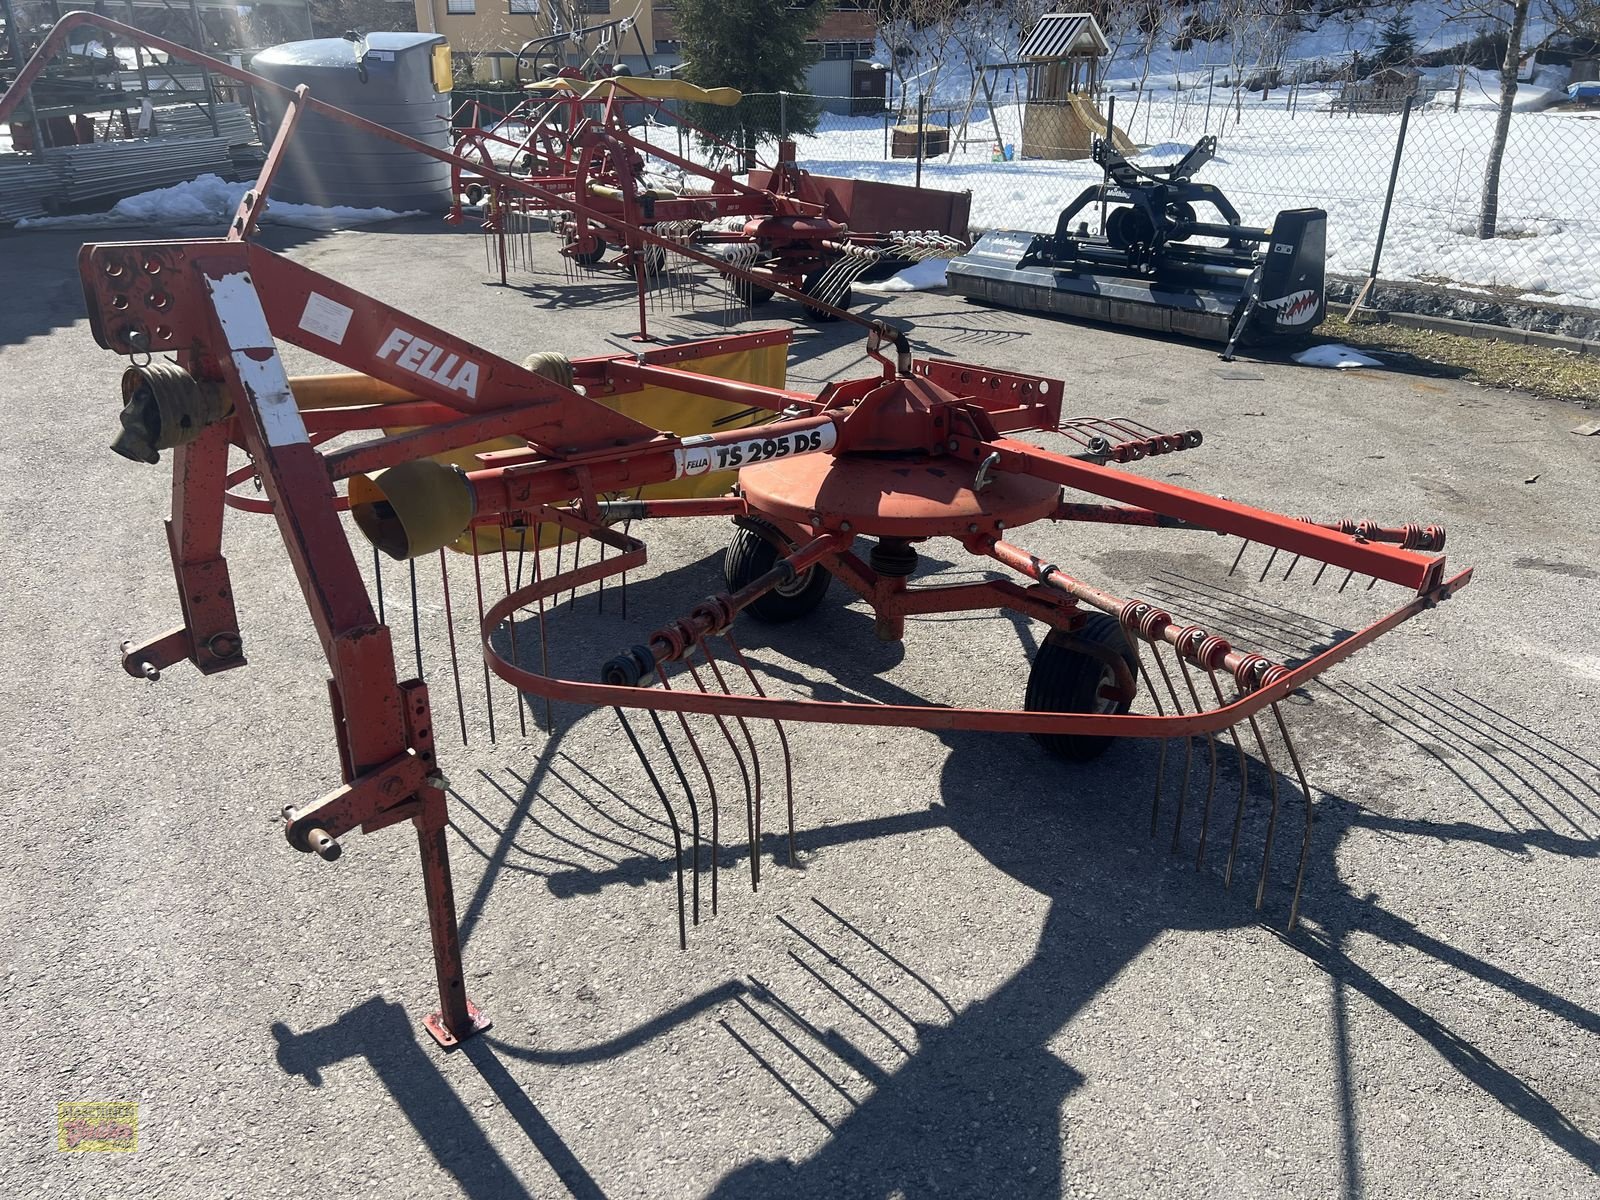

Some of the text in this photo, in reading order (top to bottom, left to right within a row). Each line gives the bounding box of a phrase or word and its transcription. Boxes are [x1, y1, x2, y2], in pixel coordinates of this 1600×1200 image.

[376, 327, 479, 399] FELLA
[686, 458, 708, 470] FELLA
[717, 431, 822, 468] TS 295 DS
